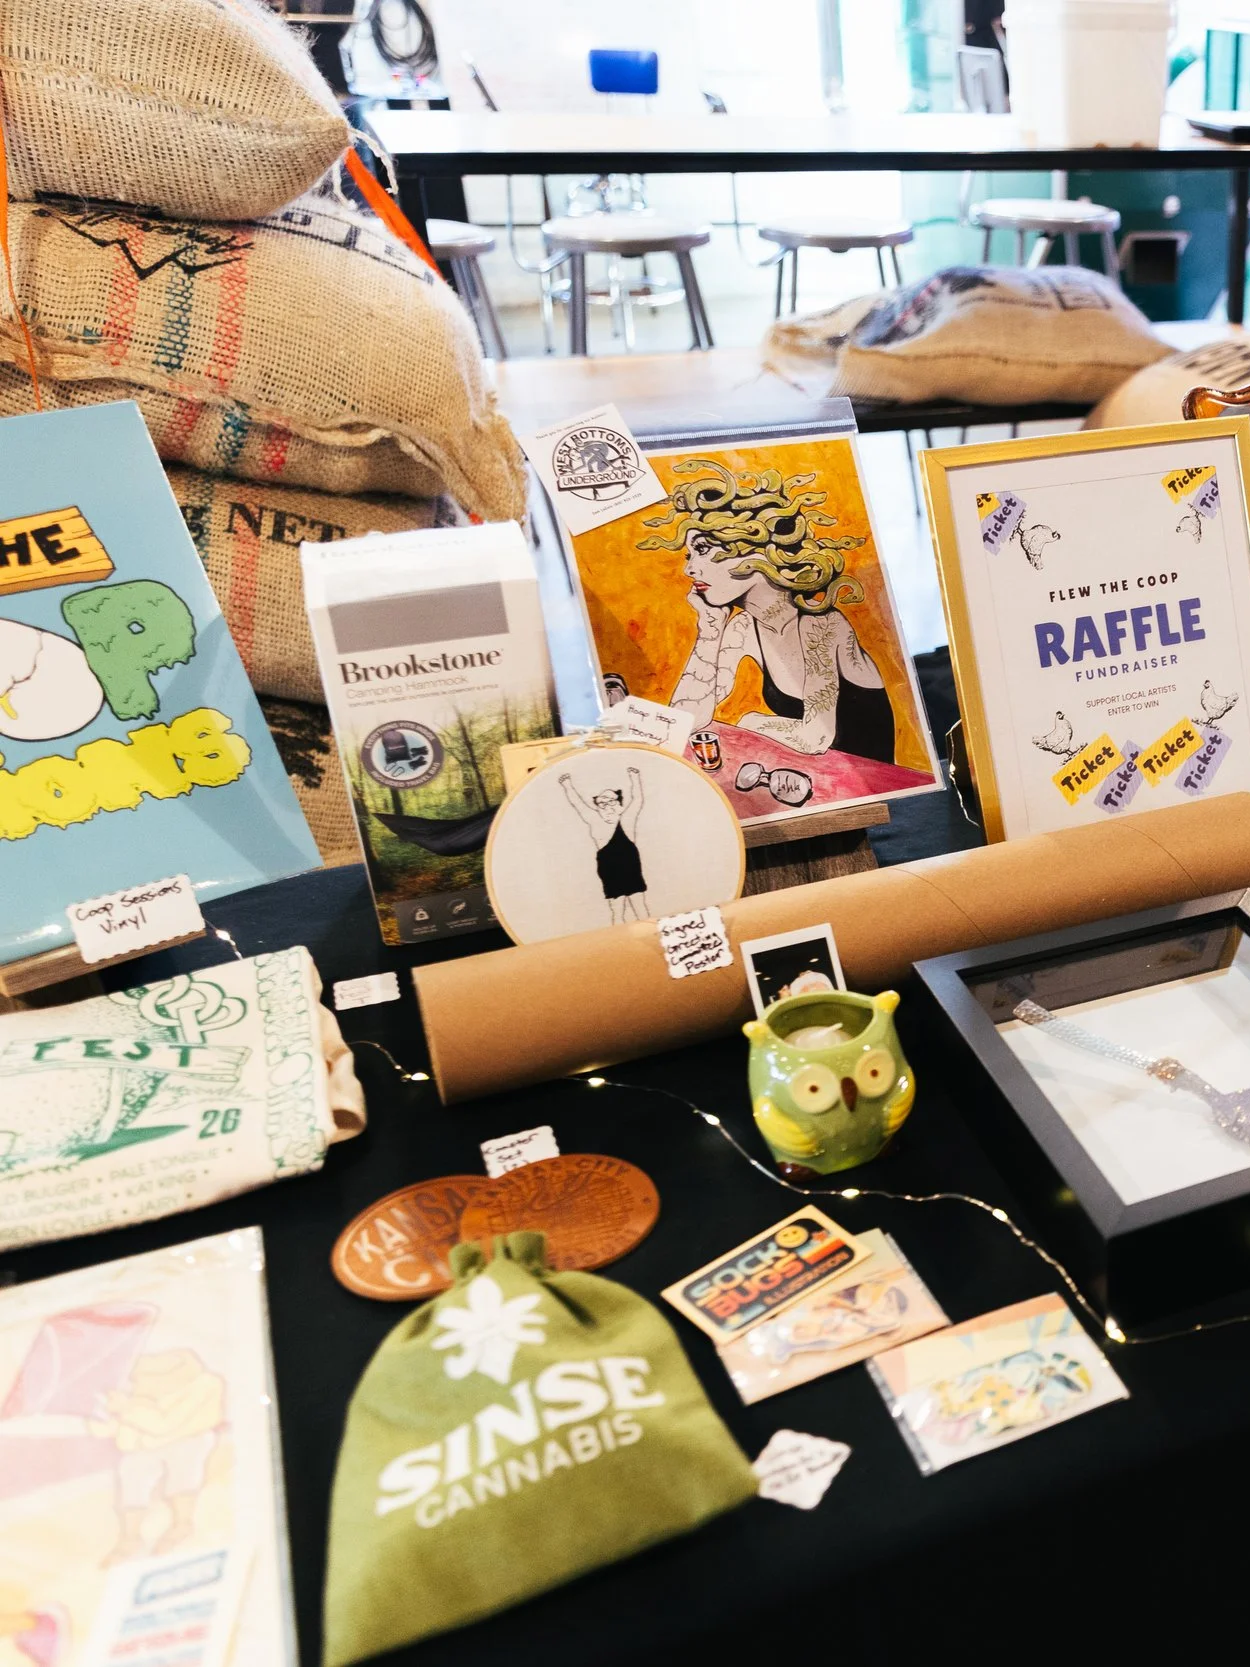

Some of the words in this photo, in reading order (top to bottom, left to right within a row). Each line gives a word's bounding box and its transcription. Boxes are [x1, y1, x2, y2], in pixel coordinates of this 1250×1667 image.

[556, 441, 572, 476] WEST
[570, 429, 632, 457] BOTTOMS
[563, 469, 637, 486] UNDERGROUND
[1167, 465, 1209, 494] Ticke
[982, 496, 1017, 545] Ticket
[1049, 585, 1091, 603] FLEW
[1100, 580, 1129, 594] THE
[1137, 572, 1179, 588] COOP
[1034, 597, 1206, 669] RAFFLE
[338, 649, 502, 685] Brookstone
[1075, 654, 1179, 683] FUNDRAISER
[346, 683, 403, 701] Camping
[404, 674, 470, 692] Hammock
[1086, 694, 1120, 709] SUPPORT
[1122, 691, 1146, 701] LOCAL
[1148, 684, 1177, 697] ARTISTS
[1108, 705, 1131, 717] ENTER
[1132, 703, 1143, 712] TO
[1144, 700, 1159, 709] WIN
[1061, 744, 1115, 793] Ticket
[1143, 729, 1195, 775] Ticket
[1183, 734, 1222, 790] Ticket
[1103, 750, 1140, 808] Ticket
[75, 901, 114, 922] Coop
[121, 882, 183, 908] Sessions
[100, 907, 147, 935] Vinyl
[661, 913, 706, 938] Signed
[685, 948, 724, 974] Poster
[32, 1036, 206, 1068] FEST
[198, 1107, 241, 1141] 26
[689, 1240, 789, 1308] SOCK
[705, 1252, 805, 1319] BUGS
[375, 1355, 667, 1518] SINSE
[415, 1411, 644, 1530] CANNABIS
